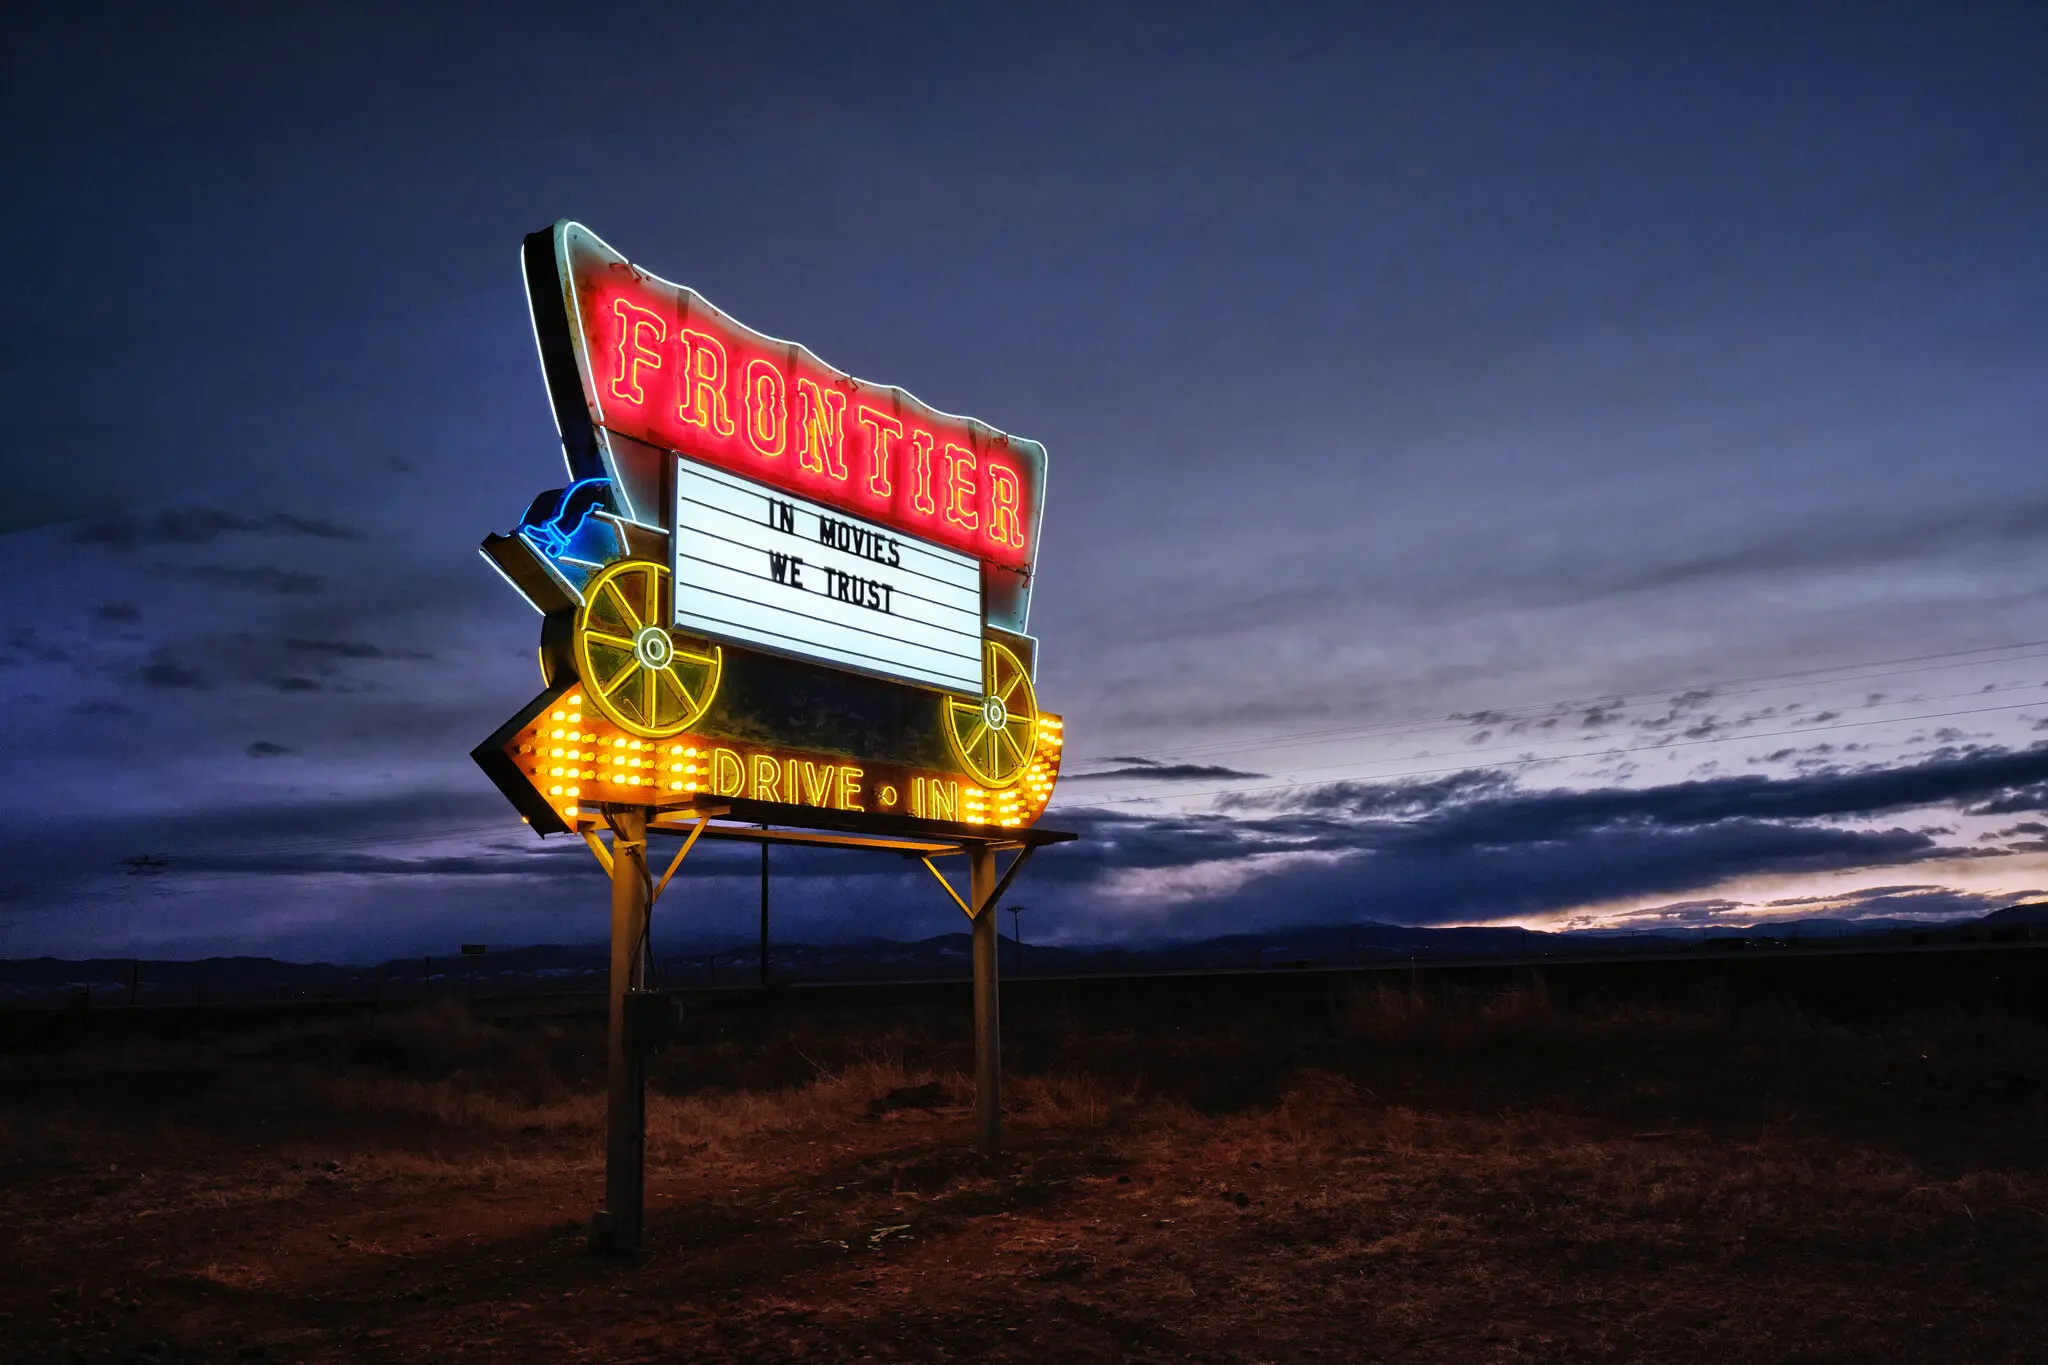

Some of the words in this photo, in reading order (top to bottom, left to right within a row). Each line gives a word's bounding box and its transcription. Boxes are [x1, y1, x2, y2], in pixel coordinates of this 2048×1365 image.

[612, 298, 1024, 548] FRONTIER
[768, 497, 794, 535] IN
[819, 515, 901, 568] MOVIES
[769, 550, 803, 590] WE
[824, 566, 894, 615] TRUST
[713, 747, 865, 812] DRIVE
[914, 776, 959, 822] IN
